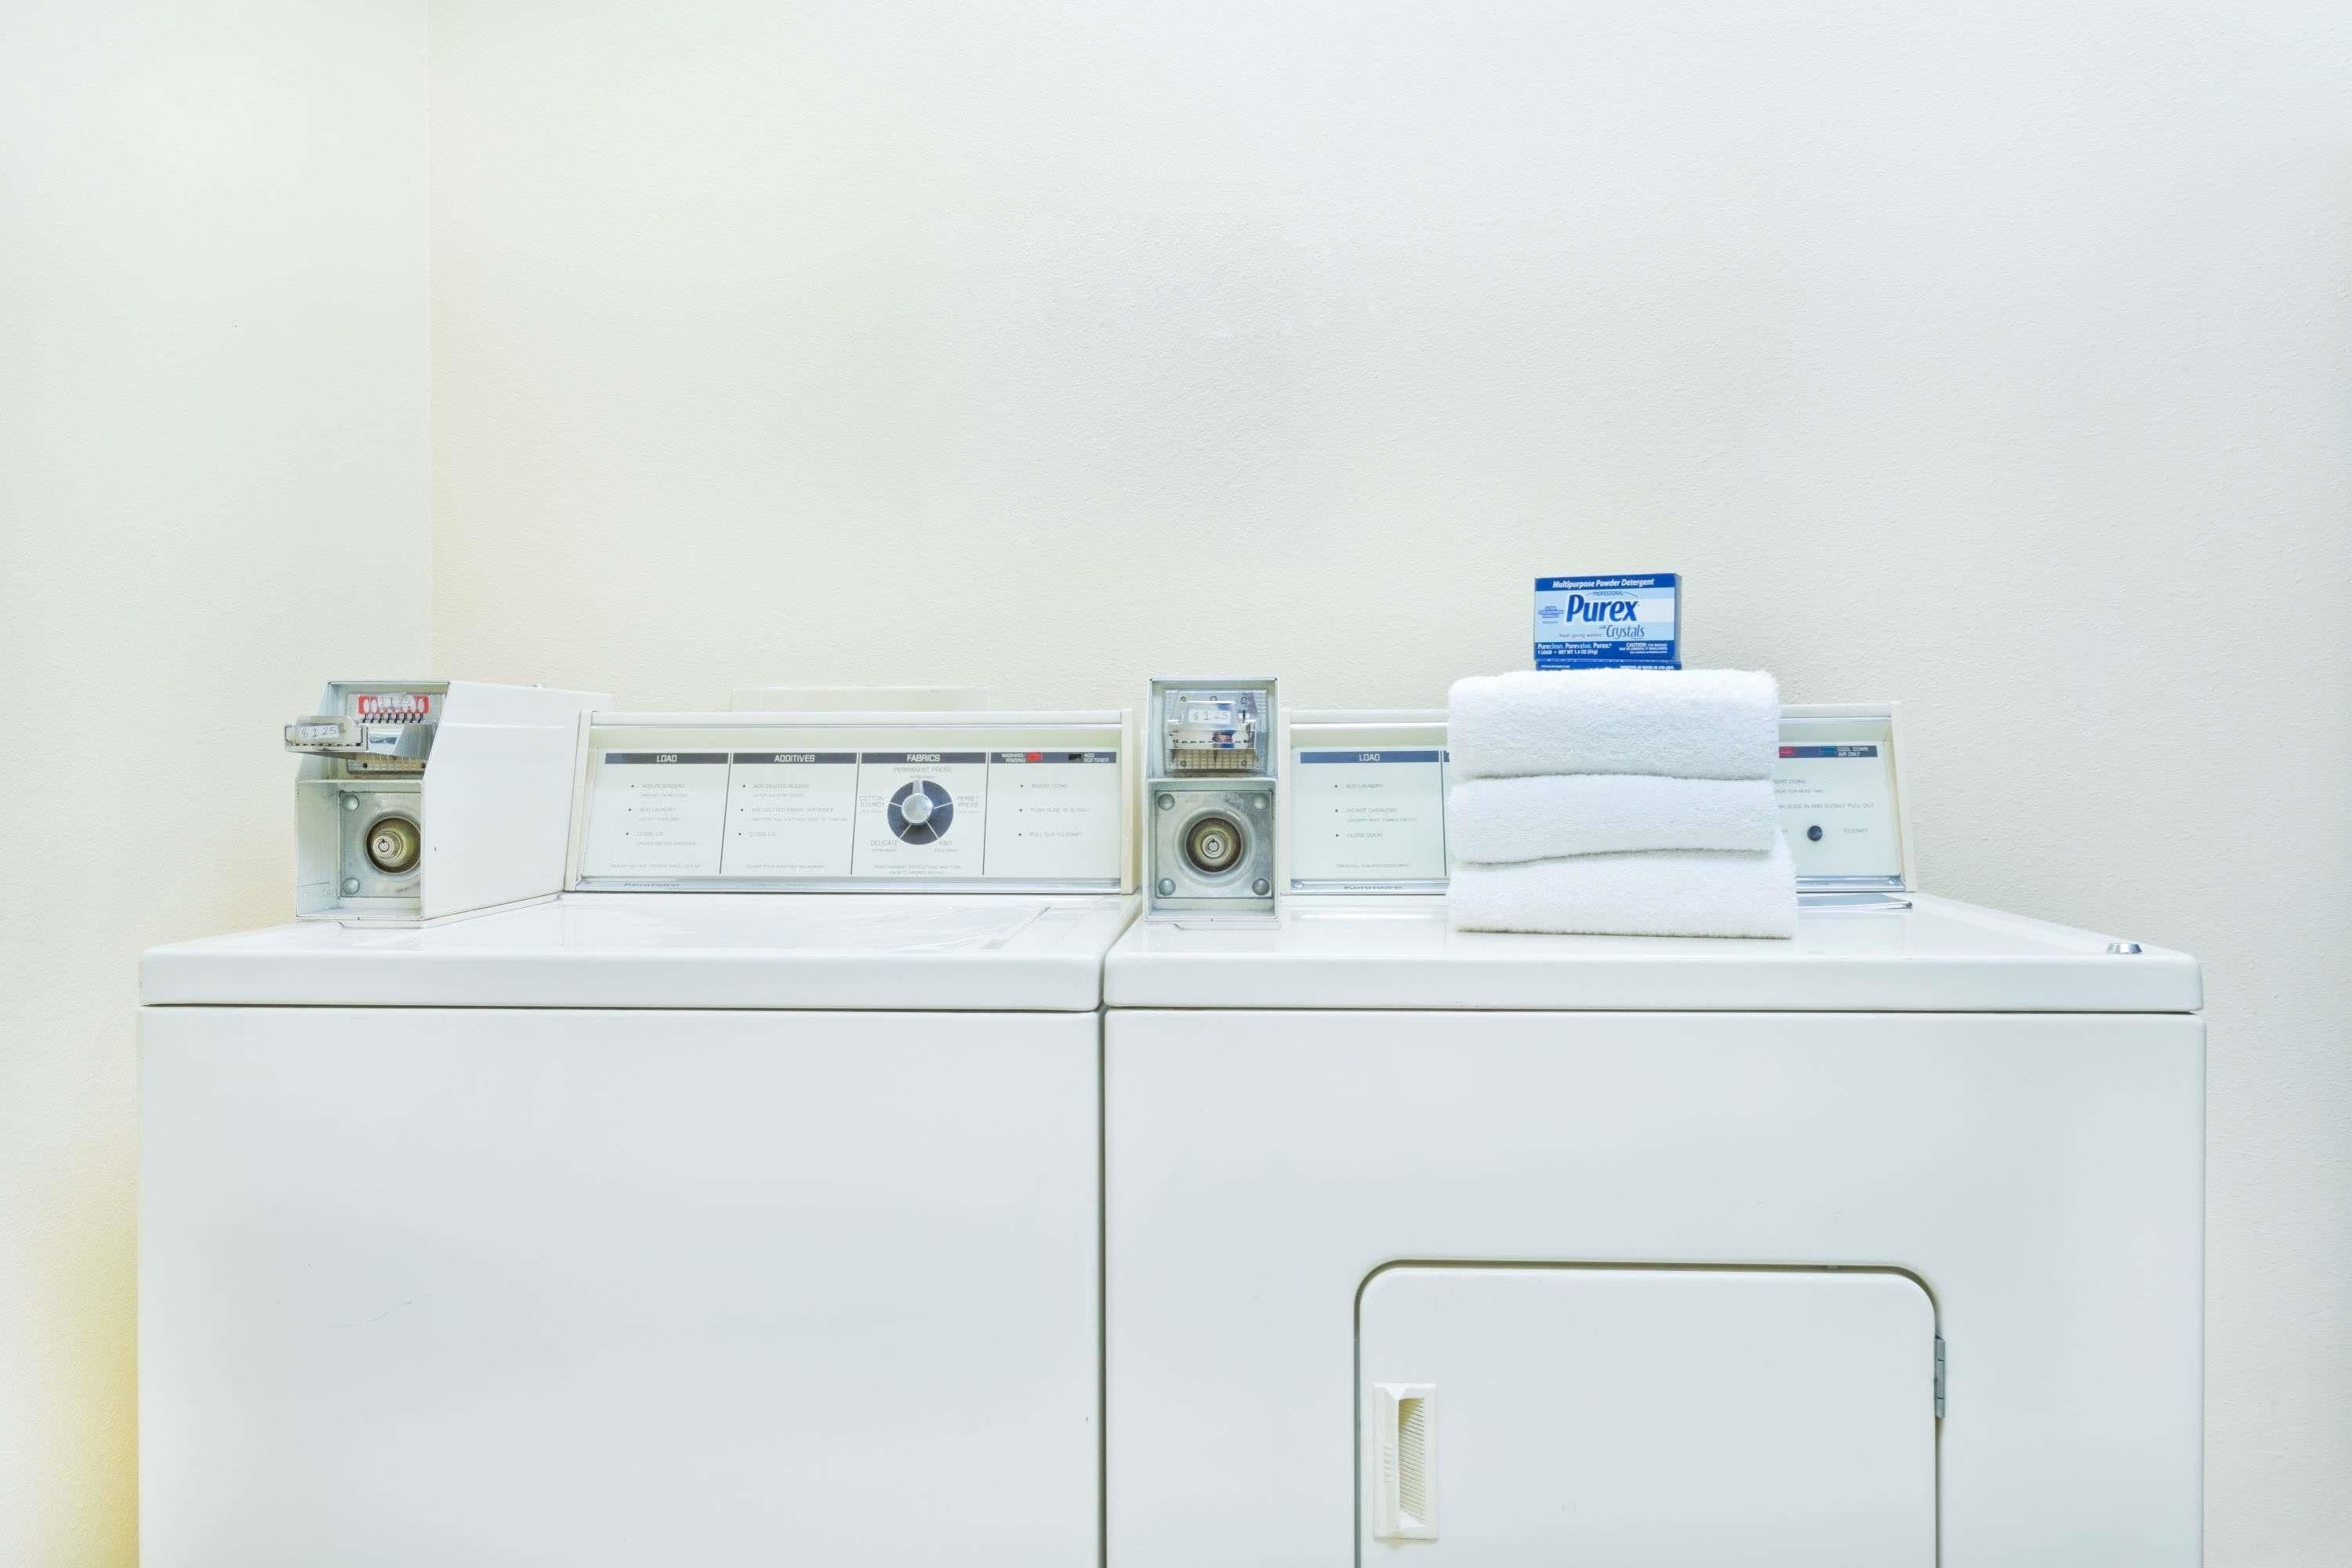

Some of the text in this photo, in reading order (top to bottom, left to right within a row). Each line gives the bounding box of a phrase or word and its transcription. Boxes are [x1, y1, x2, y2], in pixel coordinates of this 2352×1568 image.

[1552, 579, 1595, 590] Multipurpose
[1622, 577, 1655, 586] Detergent
[1566, 593, 1639, 622] Purex
[1606, 624, 1644, 639] Crystals
[656, 754, 677, 763] LOAD
[774, 754, 815, 763] ADDITIVES
